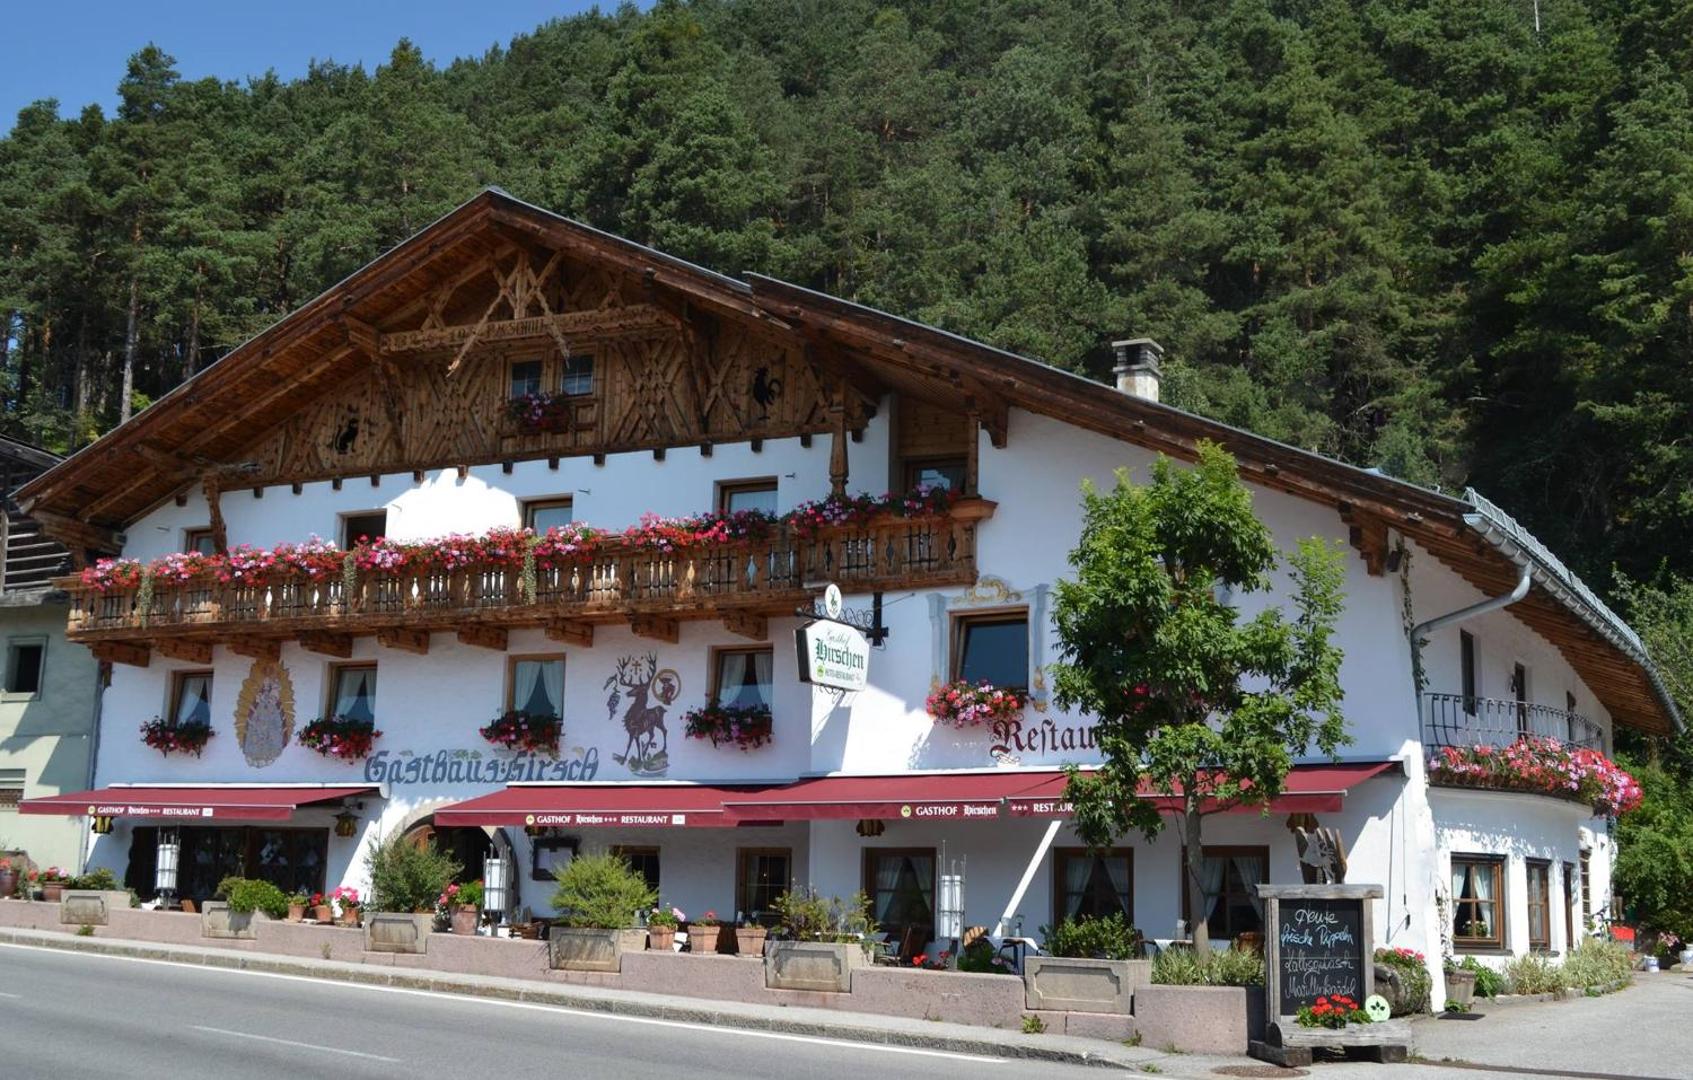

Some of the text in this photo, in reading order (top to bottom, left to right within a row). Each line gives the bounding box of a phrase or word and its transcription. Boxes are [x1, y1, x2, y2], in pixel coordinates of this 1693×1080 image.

[815, 637, 865, 670] Hirschen
[97, 805, 125, 814] GASTHOF
[162, 807, 200, 816] RESTAURANT
[916, 805, 958, 816] GASTHOF
[963, 804, 997, 817] Hirschen
[536, 814, 572, 824] GASTHOF
[620, 815, 669, 824] RESTAURANT
